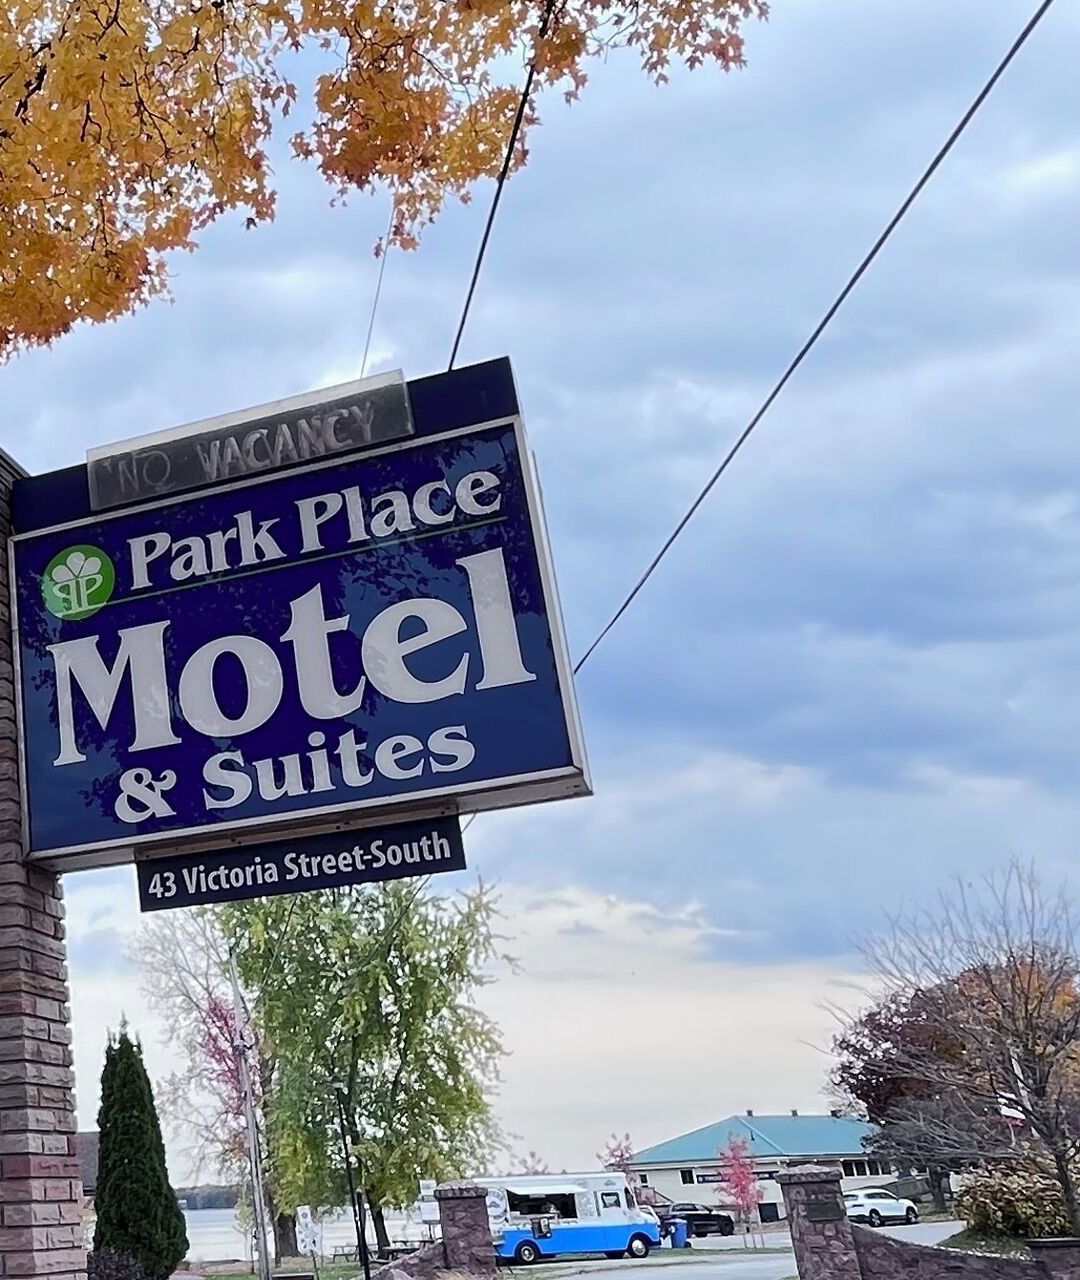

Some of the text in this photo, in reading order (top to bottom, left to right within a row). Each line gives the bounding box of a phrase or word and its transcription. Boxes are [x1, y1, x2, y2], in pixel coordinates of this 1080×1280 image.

[118, 402, 374, 494] NO VACANCY
[127, 471, 502, 589] Park Place
[46, 547, 537, 767] Motel
[114, 724, 475, 824] & Suites
[148, 871, 177, 898] 43
[182, 857, 279, 894] Victoria
